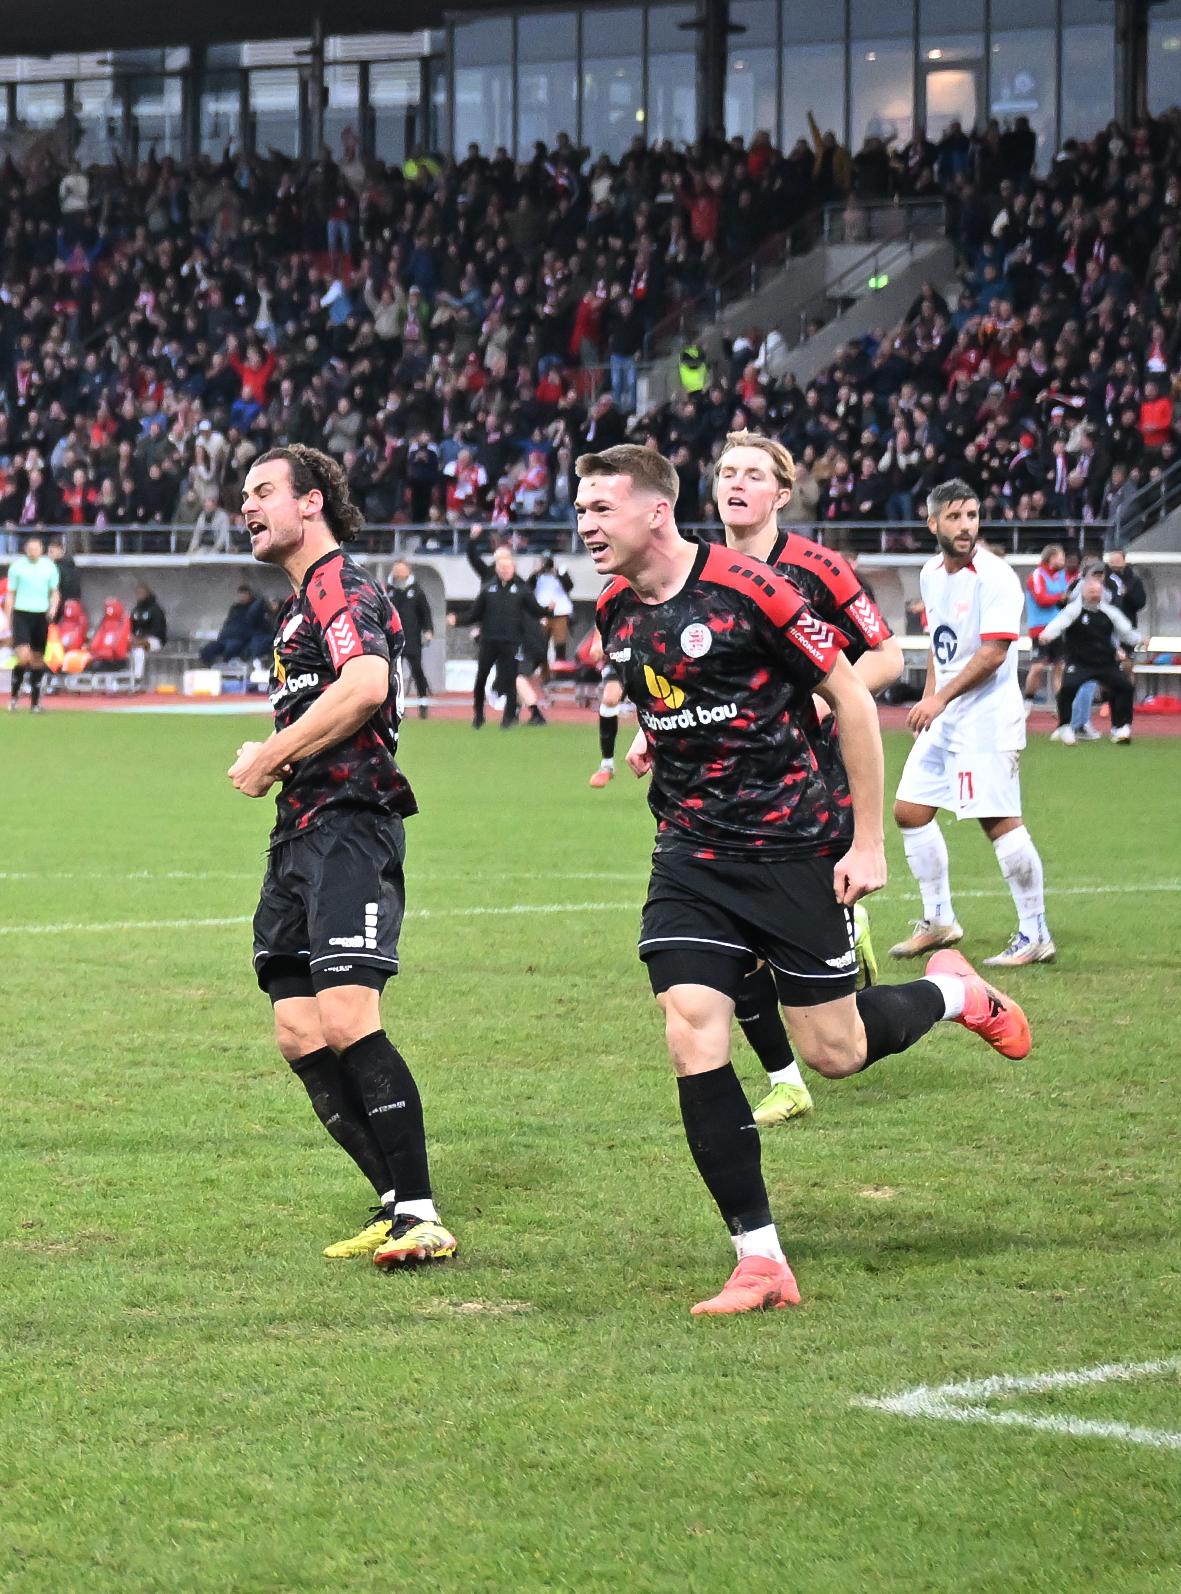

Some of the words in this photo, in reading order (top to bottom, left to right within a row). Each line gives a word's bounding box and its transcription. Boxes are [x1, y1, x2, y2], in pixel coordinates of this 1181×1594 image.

[787, 626, 825, 663] MICROMATA
[287, 673, 318, 692] bau
[696, 703, 738, 724] bau
[958, 772, 973, 800] 11
